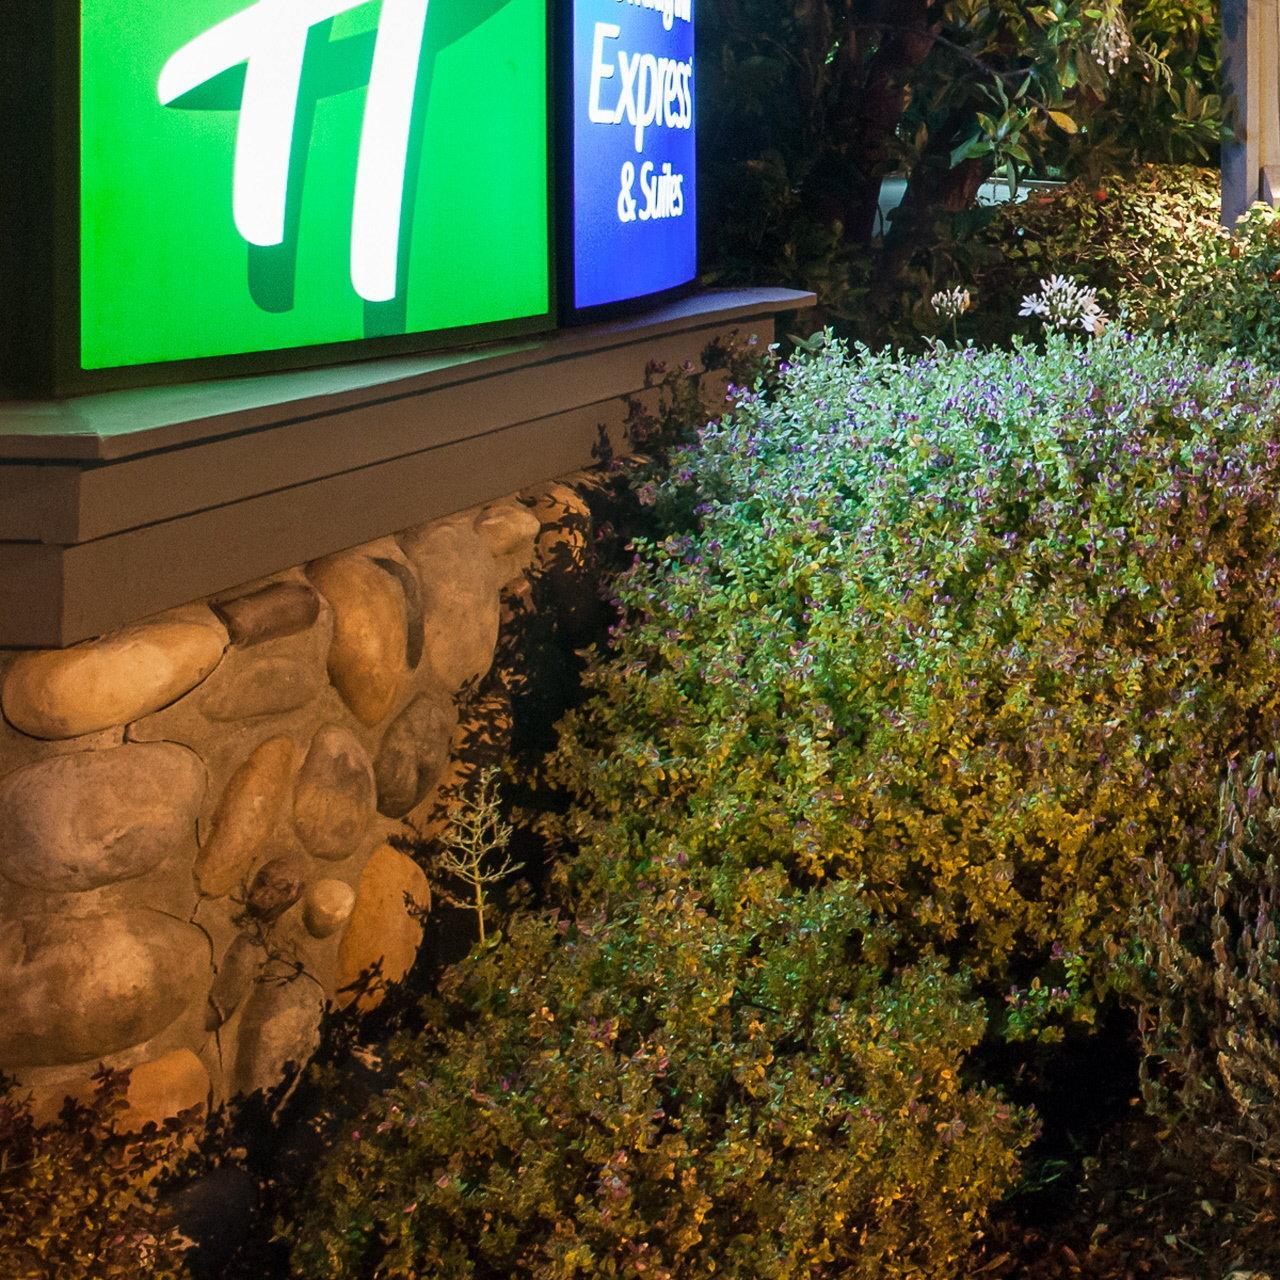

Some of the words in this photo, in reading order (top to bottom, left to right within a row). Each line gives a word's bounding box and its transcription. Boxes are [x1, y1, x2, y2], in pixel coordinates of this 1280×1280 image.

[588, 22, 692, 153] Express
[617, 161, 637, 222] &
[639, 161, 683, 220] Suites
